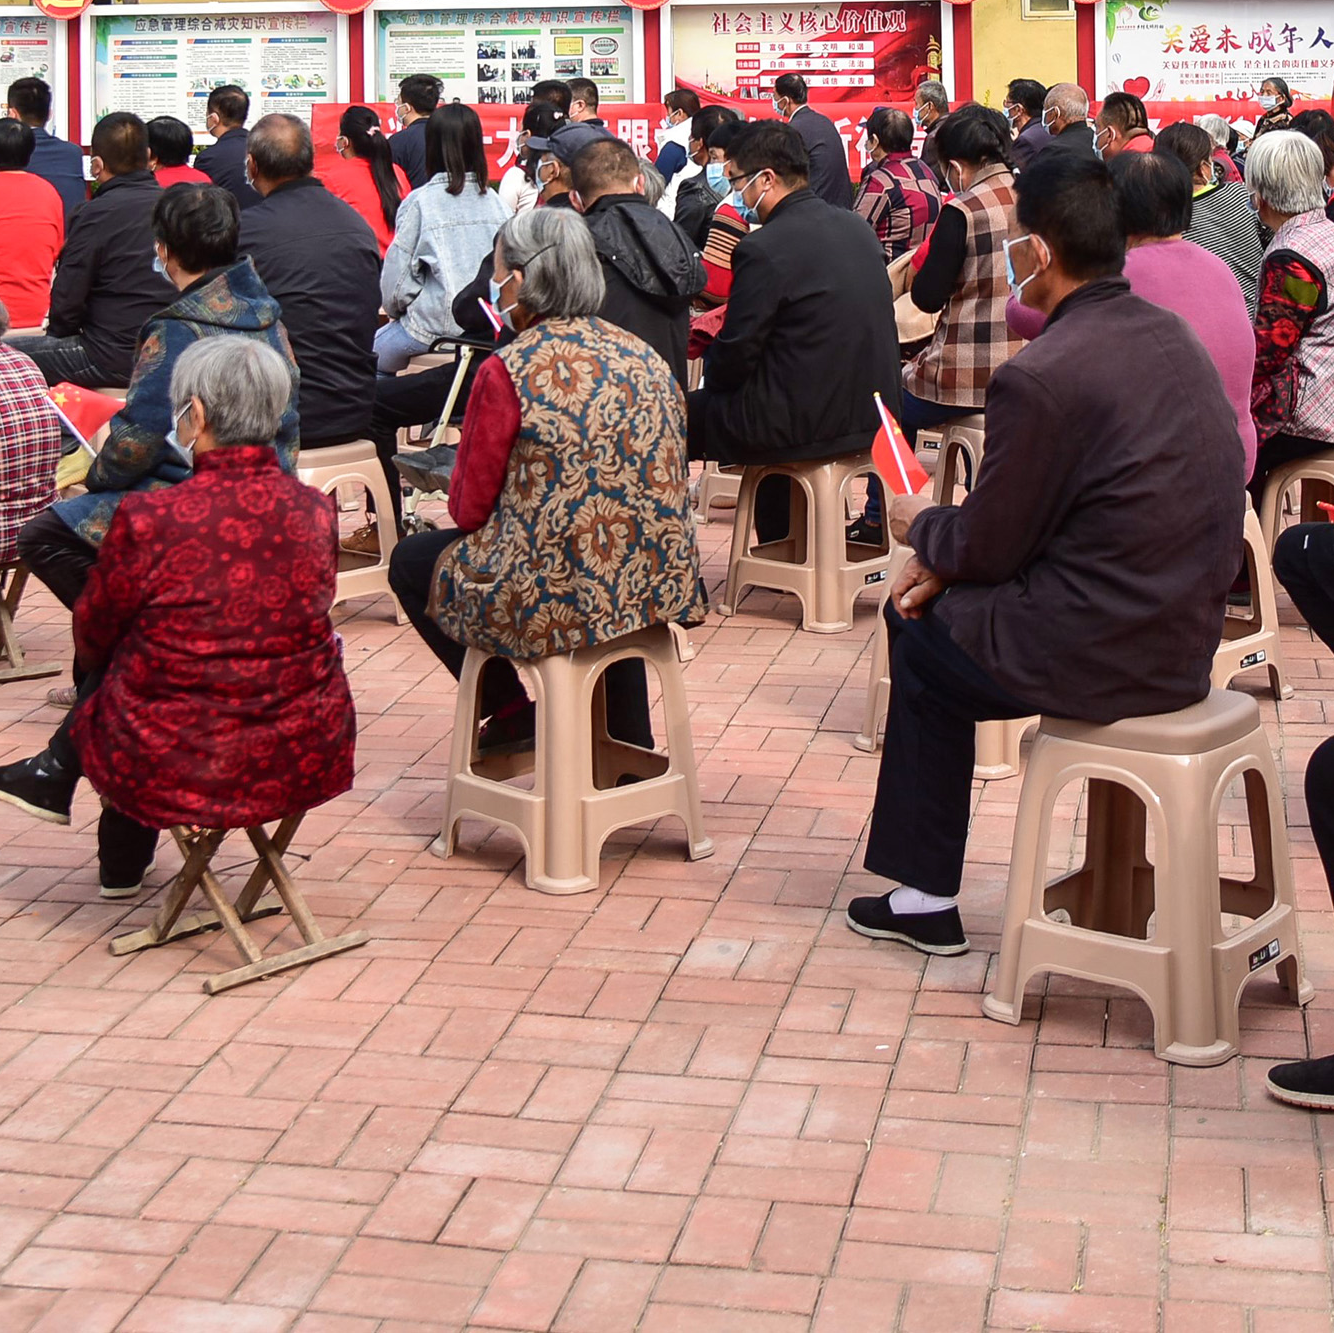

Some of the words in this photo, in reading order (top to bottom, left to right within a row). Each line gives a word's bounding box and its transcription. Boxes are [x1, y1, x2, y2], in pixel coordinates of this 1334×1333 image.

[134, 16, 308, 32] 应急管理综合减灾知识宣传栏
[405, 10, 621, 26] 应急管理综合减灾知识宣传栏
[712, 10, 907, 35] 社会主义核心价值观
[1161, 22, 1334, 55] 关爱未成年人
[822, 43, 838, 51] 文明
[848, 43, 864, 51] 和谐
[796, 60, 811, 68] 平等
[822, 60, 838, 68] 公正
[1162, 60, 1237, 70] 关爱孩子健康成长
[822, 77, 838, 85] 诚信
